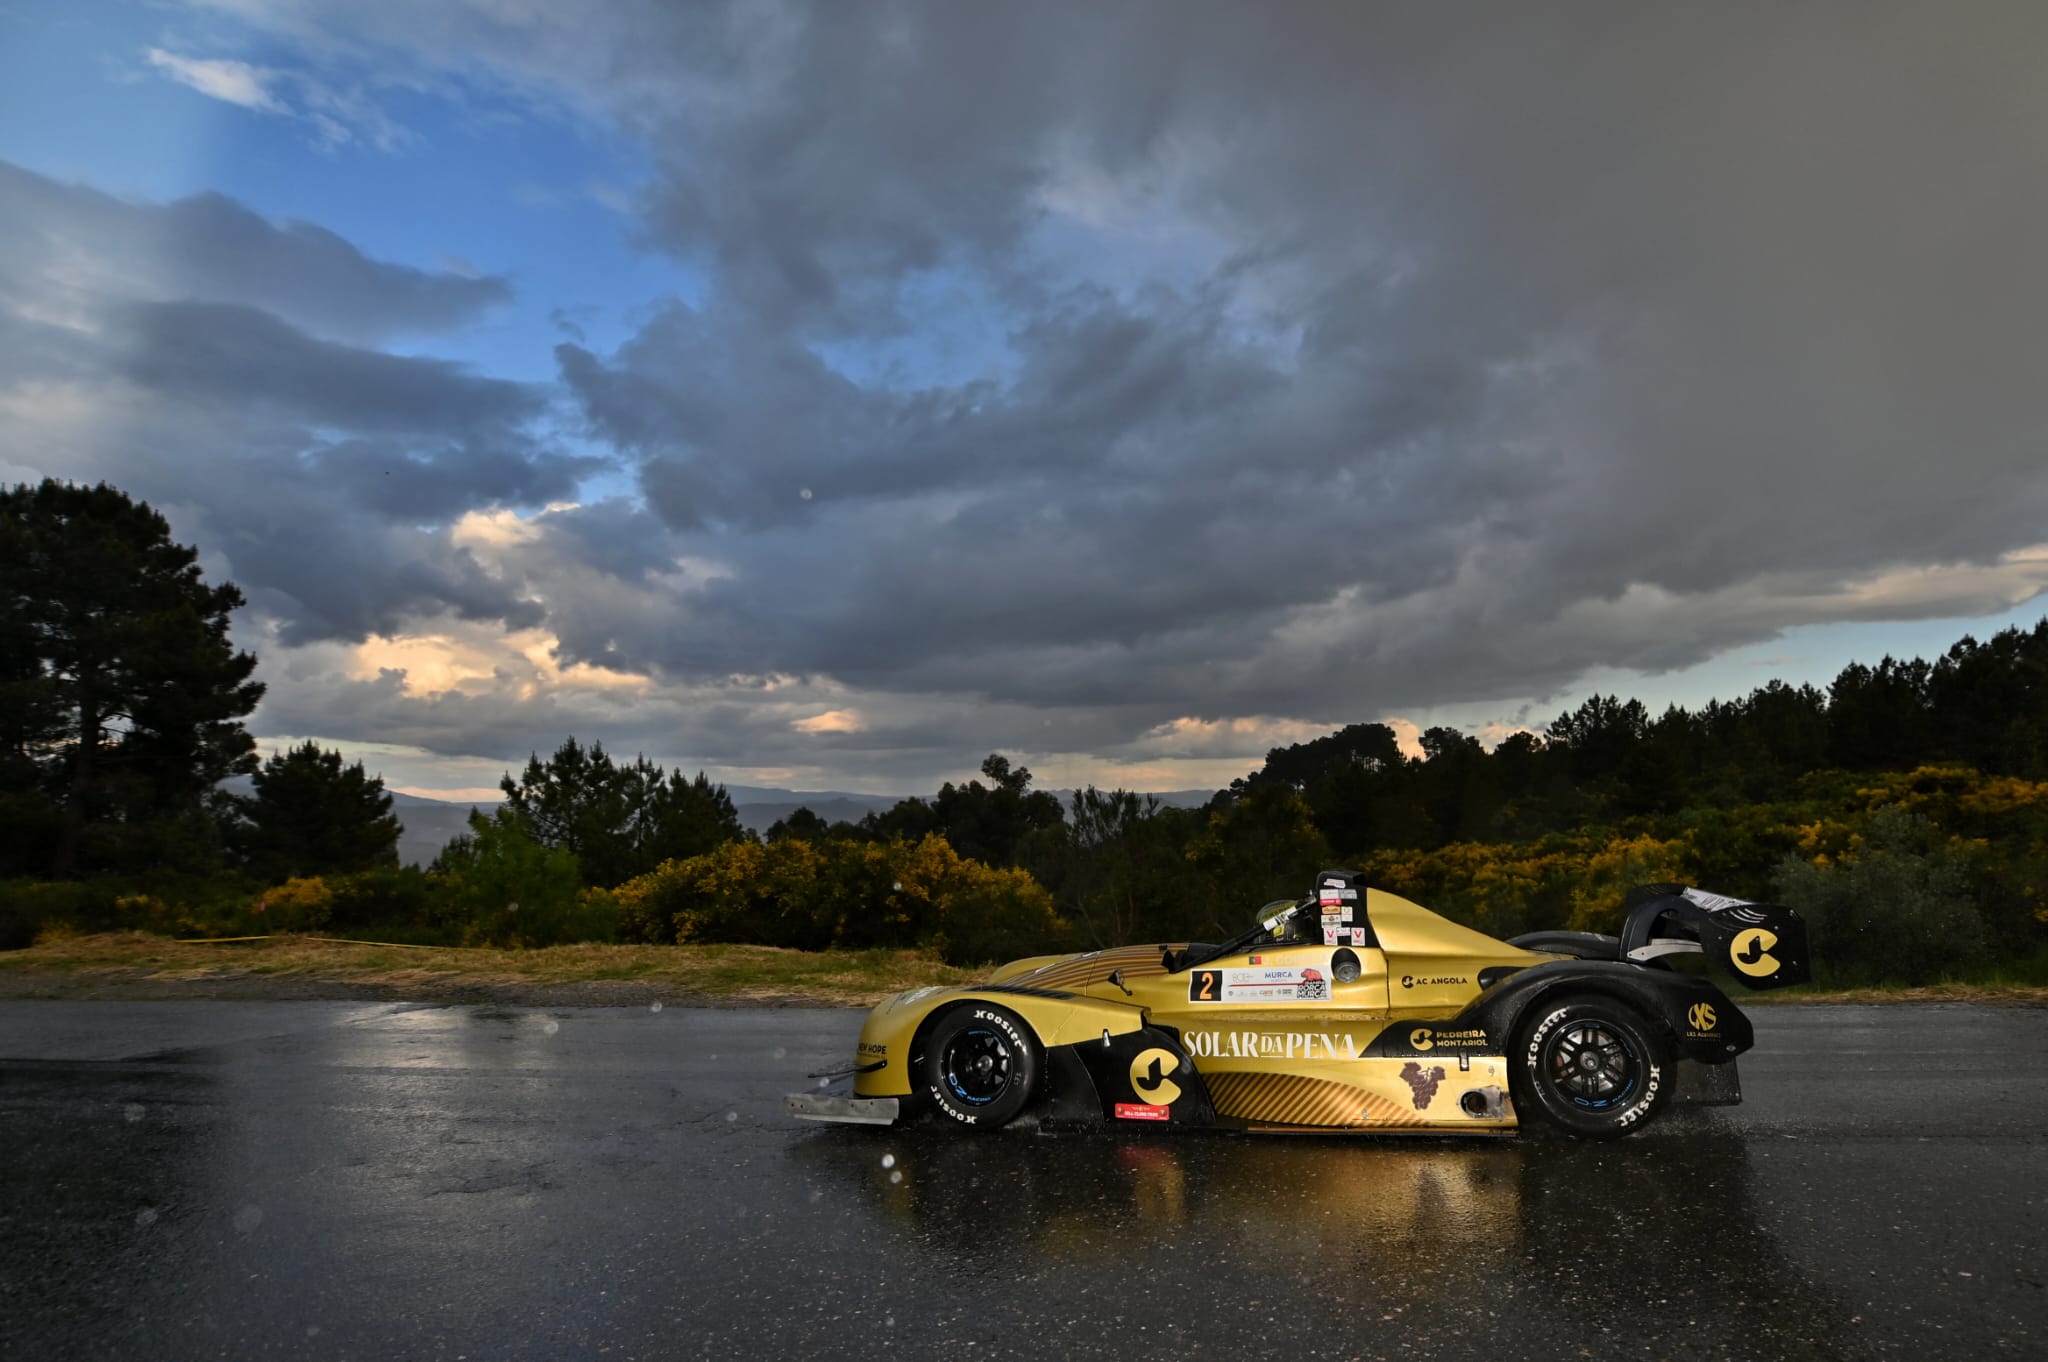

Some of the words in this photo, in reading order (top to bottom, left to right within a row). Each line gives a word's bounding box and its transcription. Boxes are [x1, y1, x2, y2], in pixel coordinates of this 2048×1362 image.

[1199, 972, 1214, 1000] 2
[1416, 977, 1428, 985] AC
[1431, 977, 1468, 985] ANGOLA
[1436, 1029, 1487, 1039] PEDREIRA
[868, 1042, 887, 1055] HOPE
[1184, 1031, 1260, 1058] SOLAR
[1261, 1035, 1284, 1053] DA
[1286, 1032, 1362, 1059] PENA
[1436, 1039, 1489, 1047] MONTARIOL
